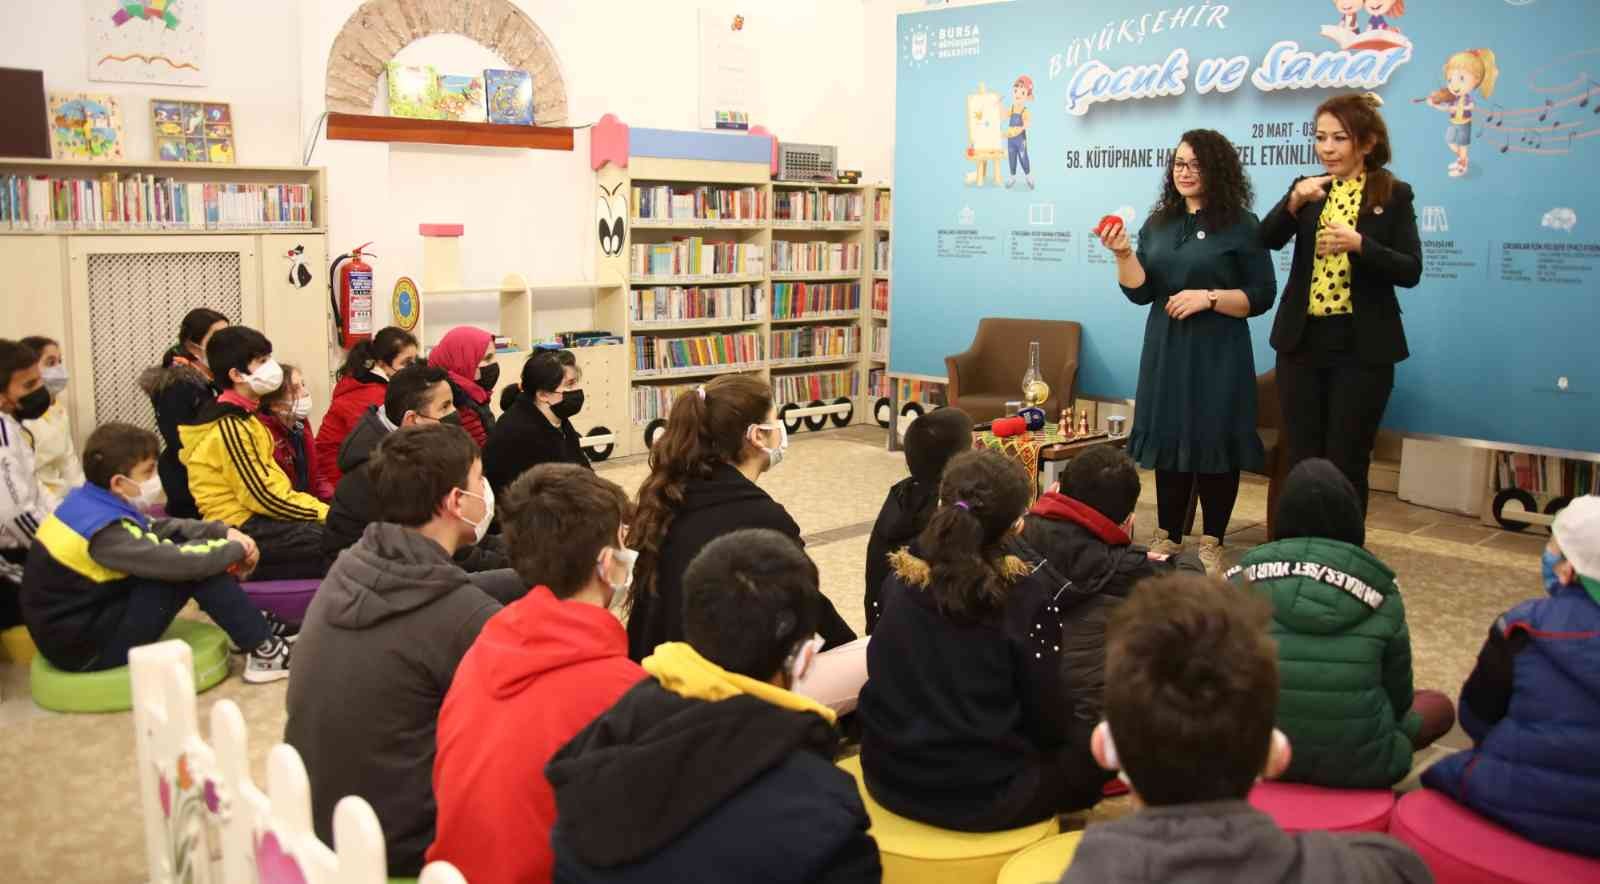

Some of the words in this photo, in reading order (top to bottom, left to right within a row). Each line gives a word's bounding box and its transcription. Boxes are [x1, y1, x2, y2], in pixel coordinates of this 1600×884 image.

[938, 24, 979, 40] BURSA
[1049, 1, 1229, 80] BÜYÜKŞEHİR
[1067, 49, 1188, 115] Çocuk
[1196, 56, 1249, 94] ve
[1252, 41, 1412, 91] Sanat
[1252, 123, 1264, 138] 28
[1267, 122, 1293, 137] MART
[1303, 121, 1316, 137] 03
[1066, 150, 1083, 169] 58.
[1086, 145, 1153, 168] KÜTÜPHANE
[1261, 139, 1320, 166] ETKİNLİK
[1258, 562, 1290, 579] YOUR
